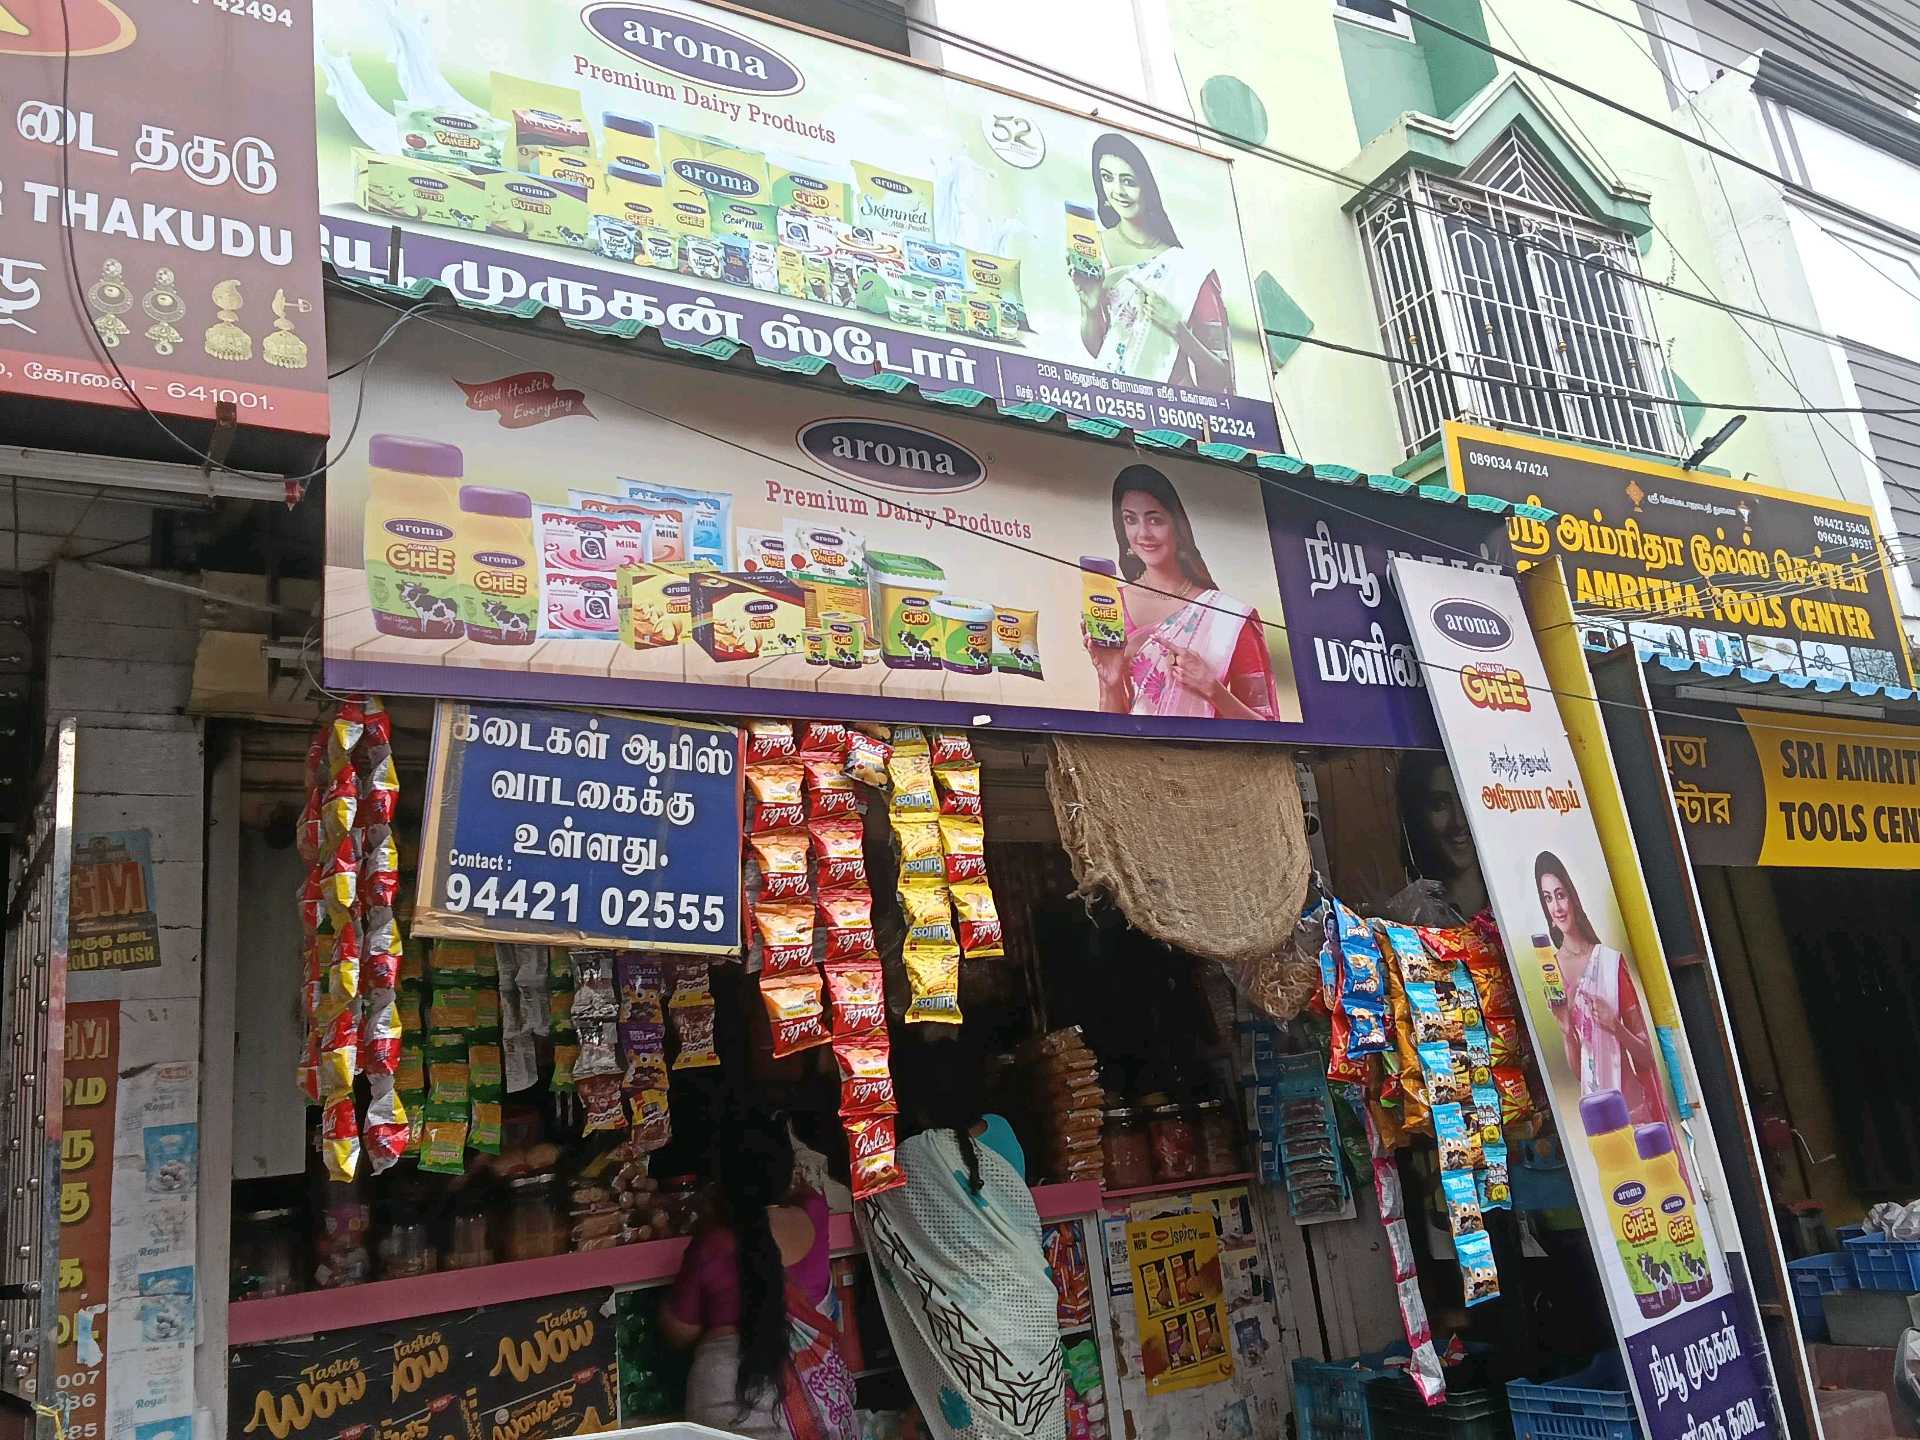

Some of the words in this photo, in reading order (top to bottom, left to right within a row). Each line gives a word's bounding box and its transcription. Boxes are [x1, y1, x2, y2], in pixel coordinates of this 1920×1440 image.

[623, 16, 769, 82] aroma
[573, 55, 676, 103] Premium
[683, 79, 742, 122] Dairy
[748, 105, 837, 145] Products
[440, 117, 473, 129] aroma
[130, 124, 278, 196] தகுடு
[413, 178, 444, 189] aroma
[680, 162, 754, 193] aroma
[794, 176, 824, 190] aroma
[875, 176, 909, 193] aroma
[413, 189, 445, 202] BUTTER
[512, 184, 551, 198] aroma
[792, 189, 829, 209] CURD
[511, 200, 552, 215] BUTTER
[860, 194, 928, 225] Skimmed
[23, 181, 293, 266] THAKUDU
[440, 258, 744, 345] முருகன்
[761, 315, 977, 386] ஸ்டோர்
[1037, 362, 1061, 381] 208,
[24, 361, 136, 392] கோவை
[166, 382, 275, 412] 641001.
[472, 390, 502, 408] Good
[506, 378, 551, 400] Health
[512, 398, 573, 422] Everyday
[1039, 384, 1092, 412] 94421
[1096, 397, 1146, 421] 02555
[1158, 405, 1205, 431] 96009
[1209, 416, 1256, 439] 52324
[831, 433, 957, 476] aroma
[1469, 451, 1512, 472] 089034
[1514, 459, 1549, 479] 47424
[765, 480, 869, 516] Premium
[876, 497, 937, 530] Dairy
[943, 507, 1032, 539] Products
[395, 524, 444, 537] aroma
[655, 528, 679, 540] Milk
[1813, 514, 1846, 531] 094422
[1846, 520, 1870, 536] 55436
[615, 539, 639, 549] Milk
[814, 535, 840, 544] aroma
[1556, 508, 1684, 572] அம்ரிதா
[1817, 530, 1849, 546] 096294
[386, 543, 456, 576] GHEE
[480, 554, 519, 566] aroma
[1304, 520, 1381, 608] நியூ
[474, 571, 527, 595] GHEE
[749, 603, 774, 612] aroma
[1091, 606, 1118, 620] GHEE
[1576, 567, 1701, 622] AMRITHA
[1711, 586, 1784, 630] TOOLS
[1791, 597, 1877, 641] CENTER
[901, 611, 932, 625] CURD
[1444, 610, 1502, 637] aroma
[997, 625, 1022, 638] CURD
[1475, 661, 1506, 674] AGMARK
[1461, 665, 1531, 713] GHEE
[452, 713, 611, 761] கடைகள்
[621, 733, 734, 776] ஆபிஸ்
[754, 735, 797, 757] Parle's
[1779, 738, 1828, 780] SRI
[1836, 743, 1920, 785] AMRIT
[491, 770, 696, 826] வாடகைக்கு
[820, 790, 857, 811] Parle's
[1481, 782, 1546, 813] அரோமா
[1545, 780, 1582, 816] நெய்
[760, 803, 804, 825] Parle's
[1779, 801, 1868, 843] TOOLS
[1873, 805, 1920, 844] CEN
[513, 816, 670, 877] உள்ளது.
[449, 849, 505, 871] Contact
[829, 858, 867, 880] Parle's
[767, 874, 810, 896] Parle's
[445, 873, 580, 923] 94421
[600, 887, 725, 933] 02555
[836, 928, 875, 950] Parle's
[103, 946, 155, 966] POLISH
[769, 946, 814, 968] Parle's
[843, 1004, 886, 1027] Parle's
[780, 1018, 822, 1041] Parle's
[852, 1078, 894, 1101] Parle's
[854, 1127, 891, 1156] Parle's
[1617, 1185, 1643, 1202] aroma
[1622, 1207, 1658, 1244] GHEE
[1667, 1215, 1696, 1243] GHEE
[537, 1305, 588, 1333] Tastes
[300, 1355, 361, 1385] Tastes
[1649, 1345, 1689, 1411] நியூ
[1684, 1310, 1741, 1391] முருகன்
